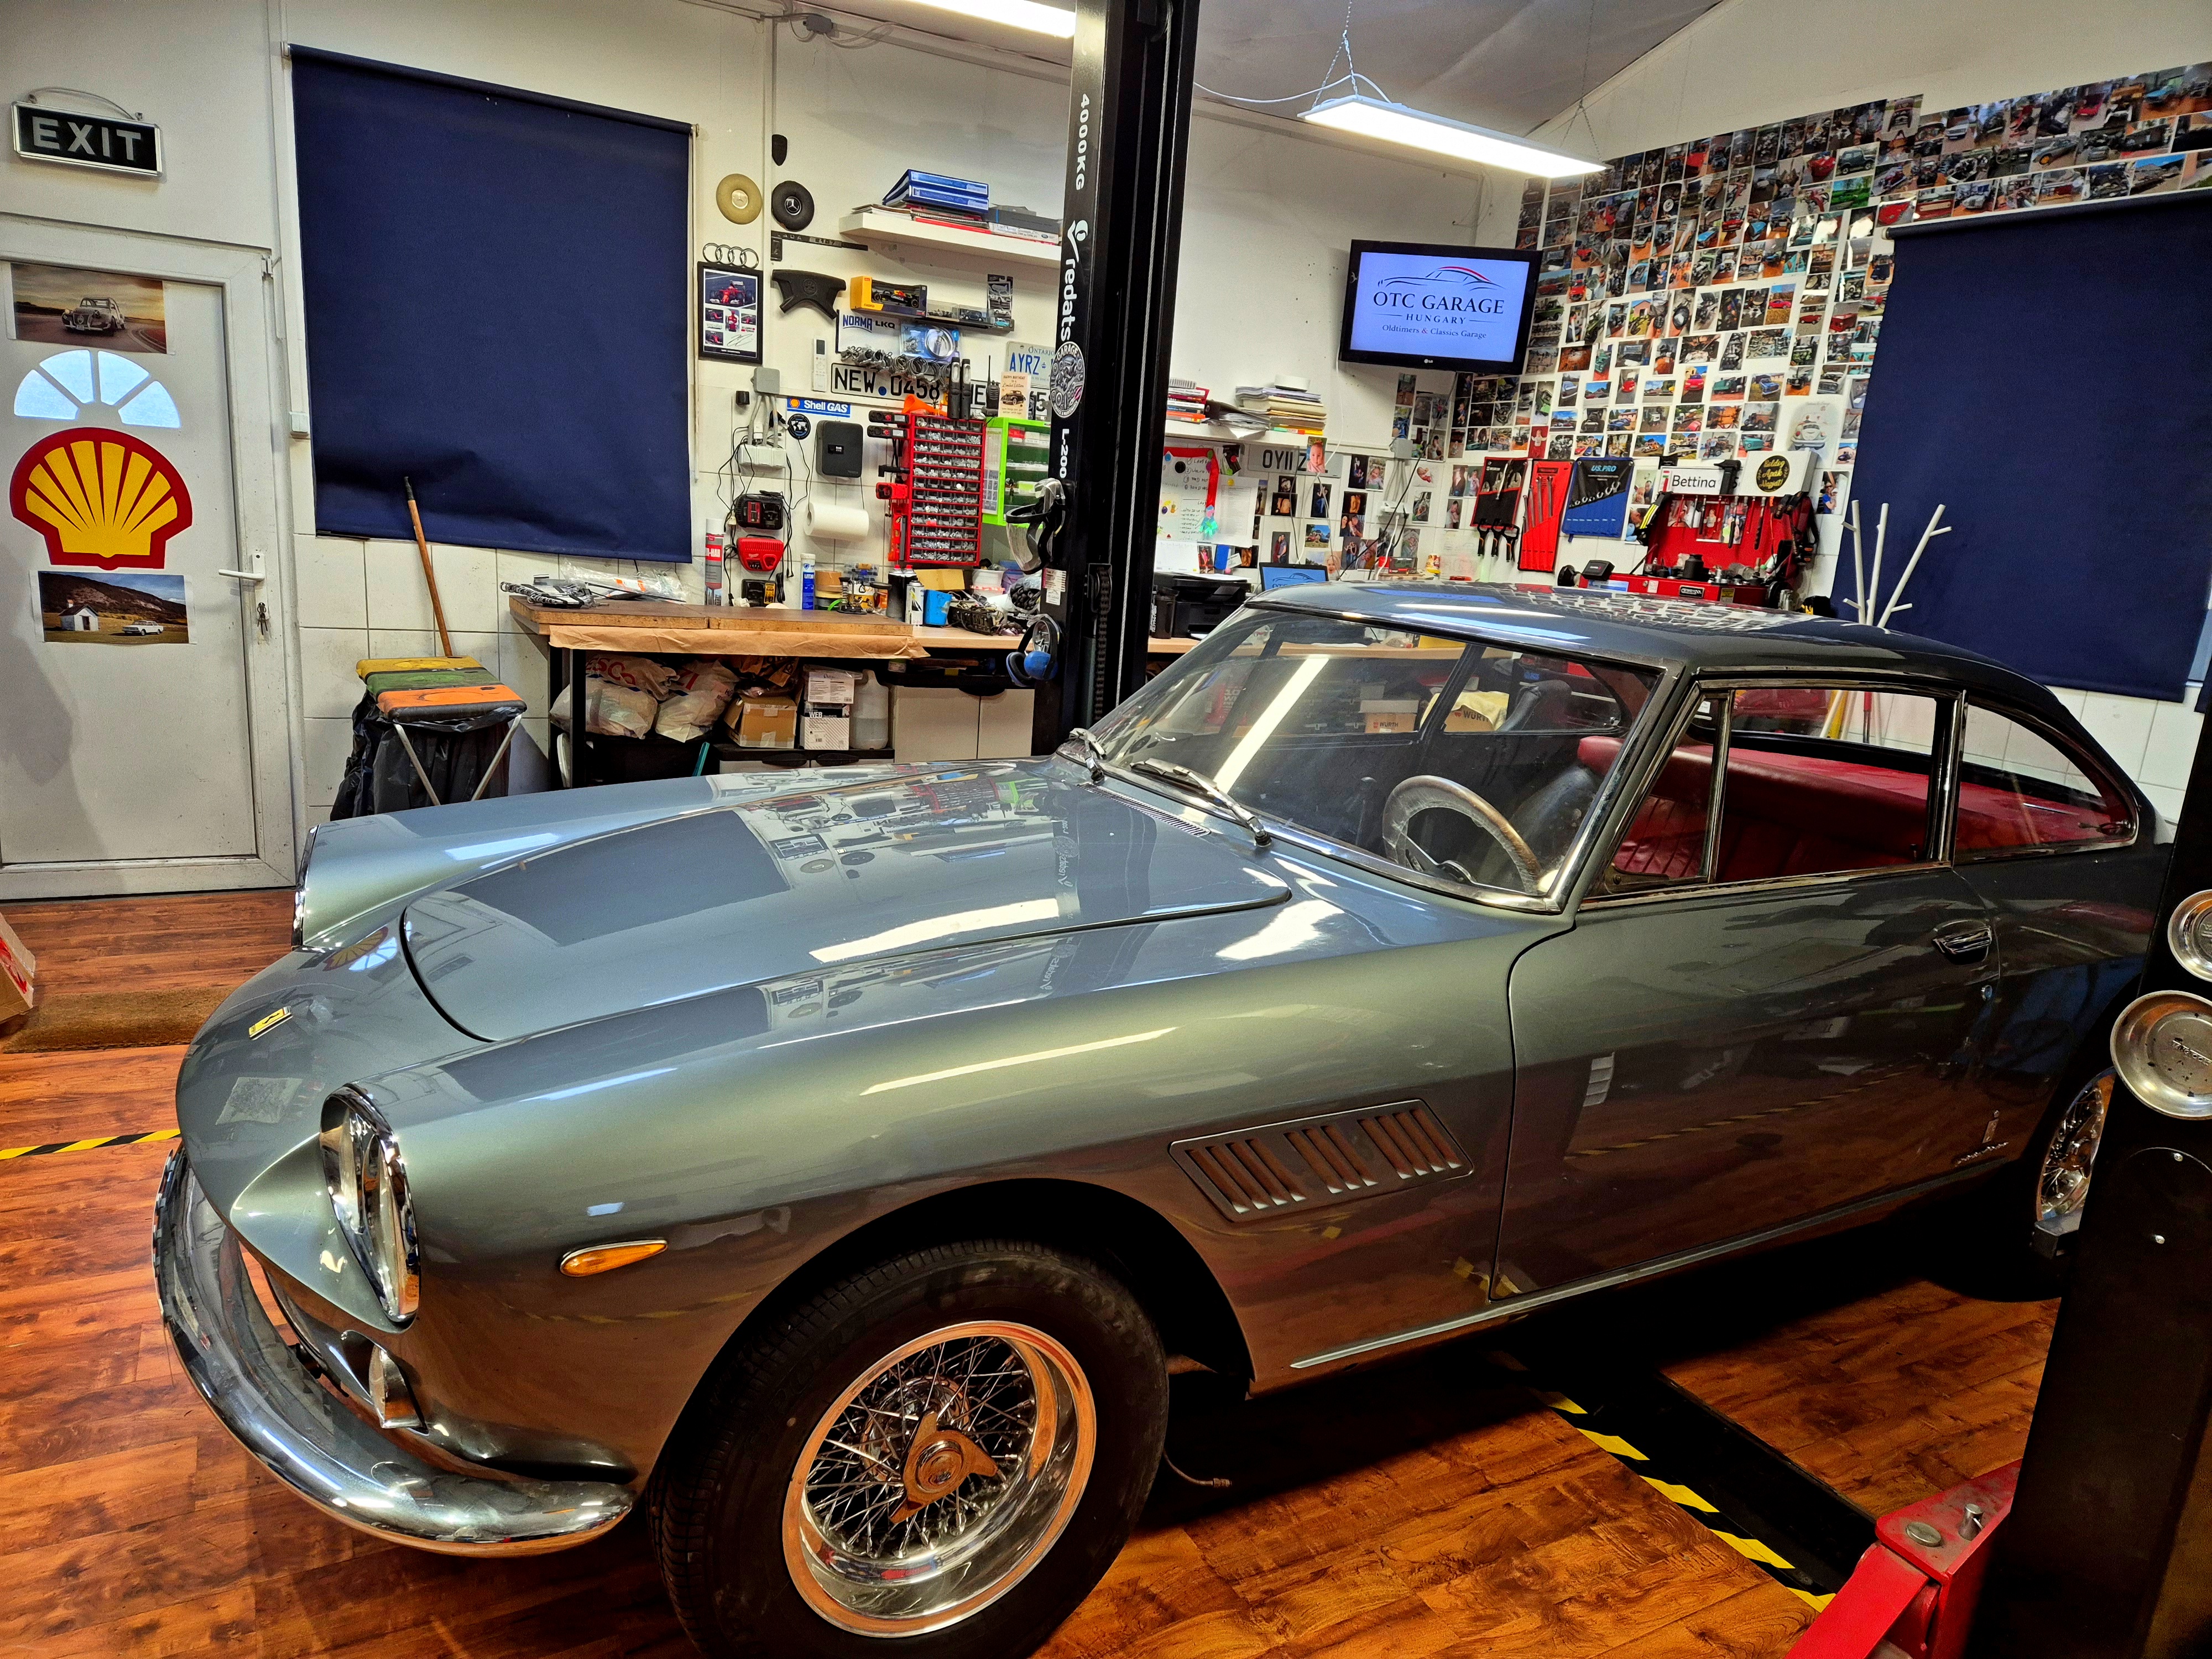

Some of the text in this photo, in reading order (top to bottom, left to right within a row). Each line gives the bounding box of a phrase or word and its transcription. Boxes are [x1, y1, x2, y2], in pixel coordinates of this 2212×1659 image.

[32, 117, 141, 160] EXIT
[1076, 93, 1089, 190] 4000KG
[1061, 258, 1077, 341] redats
[1374, 291, 1505, 314] OTC GARAGE
[843, 314, 895, 331] NORMA LKQ
[1406, 314, 1467, 325] HUNGARY
[1383, 324, 1420, 334] Oldtimers
[1430, 328, 1459, 337] Classics
[1461, 330, 1486, 339] Garage
[1057, 344, 1078, 361] GARAGE
[1009, 352, 1041, 375] AYRZ
[834, 367, 876, 393] NEW
[804, 400, 848, 413] Shell GAS
[1060, 429, 1070, 478] L-200
[1672, 475, 1717, 488] Bettina
[1463, 710, 1489, 722] WÜRT
